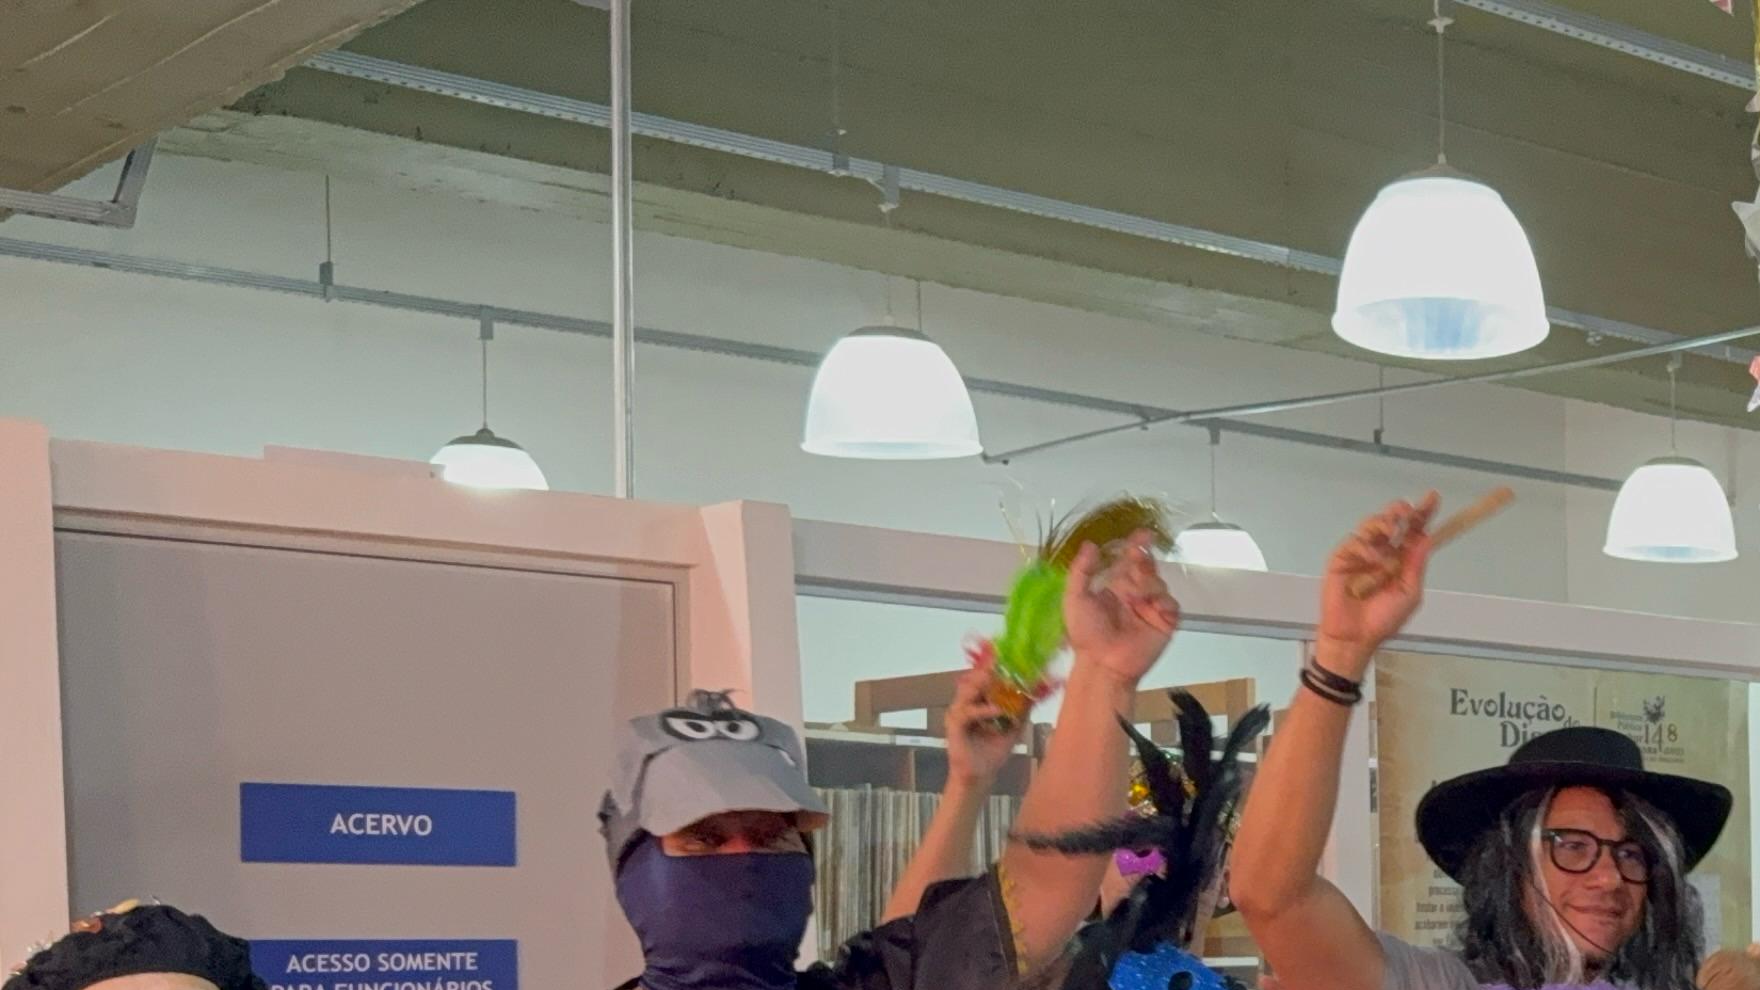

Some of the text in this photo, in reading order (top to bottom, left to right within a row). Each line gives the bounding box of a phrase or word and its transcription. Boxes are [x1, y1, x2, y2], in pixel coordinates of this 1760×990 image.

[1450, 688, 1566, 724] Evolução
[330, 813, 433, 836] ACERVO
[286, 953, 478, 973] ACESSO SOMENTE
